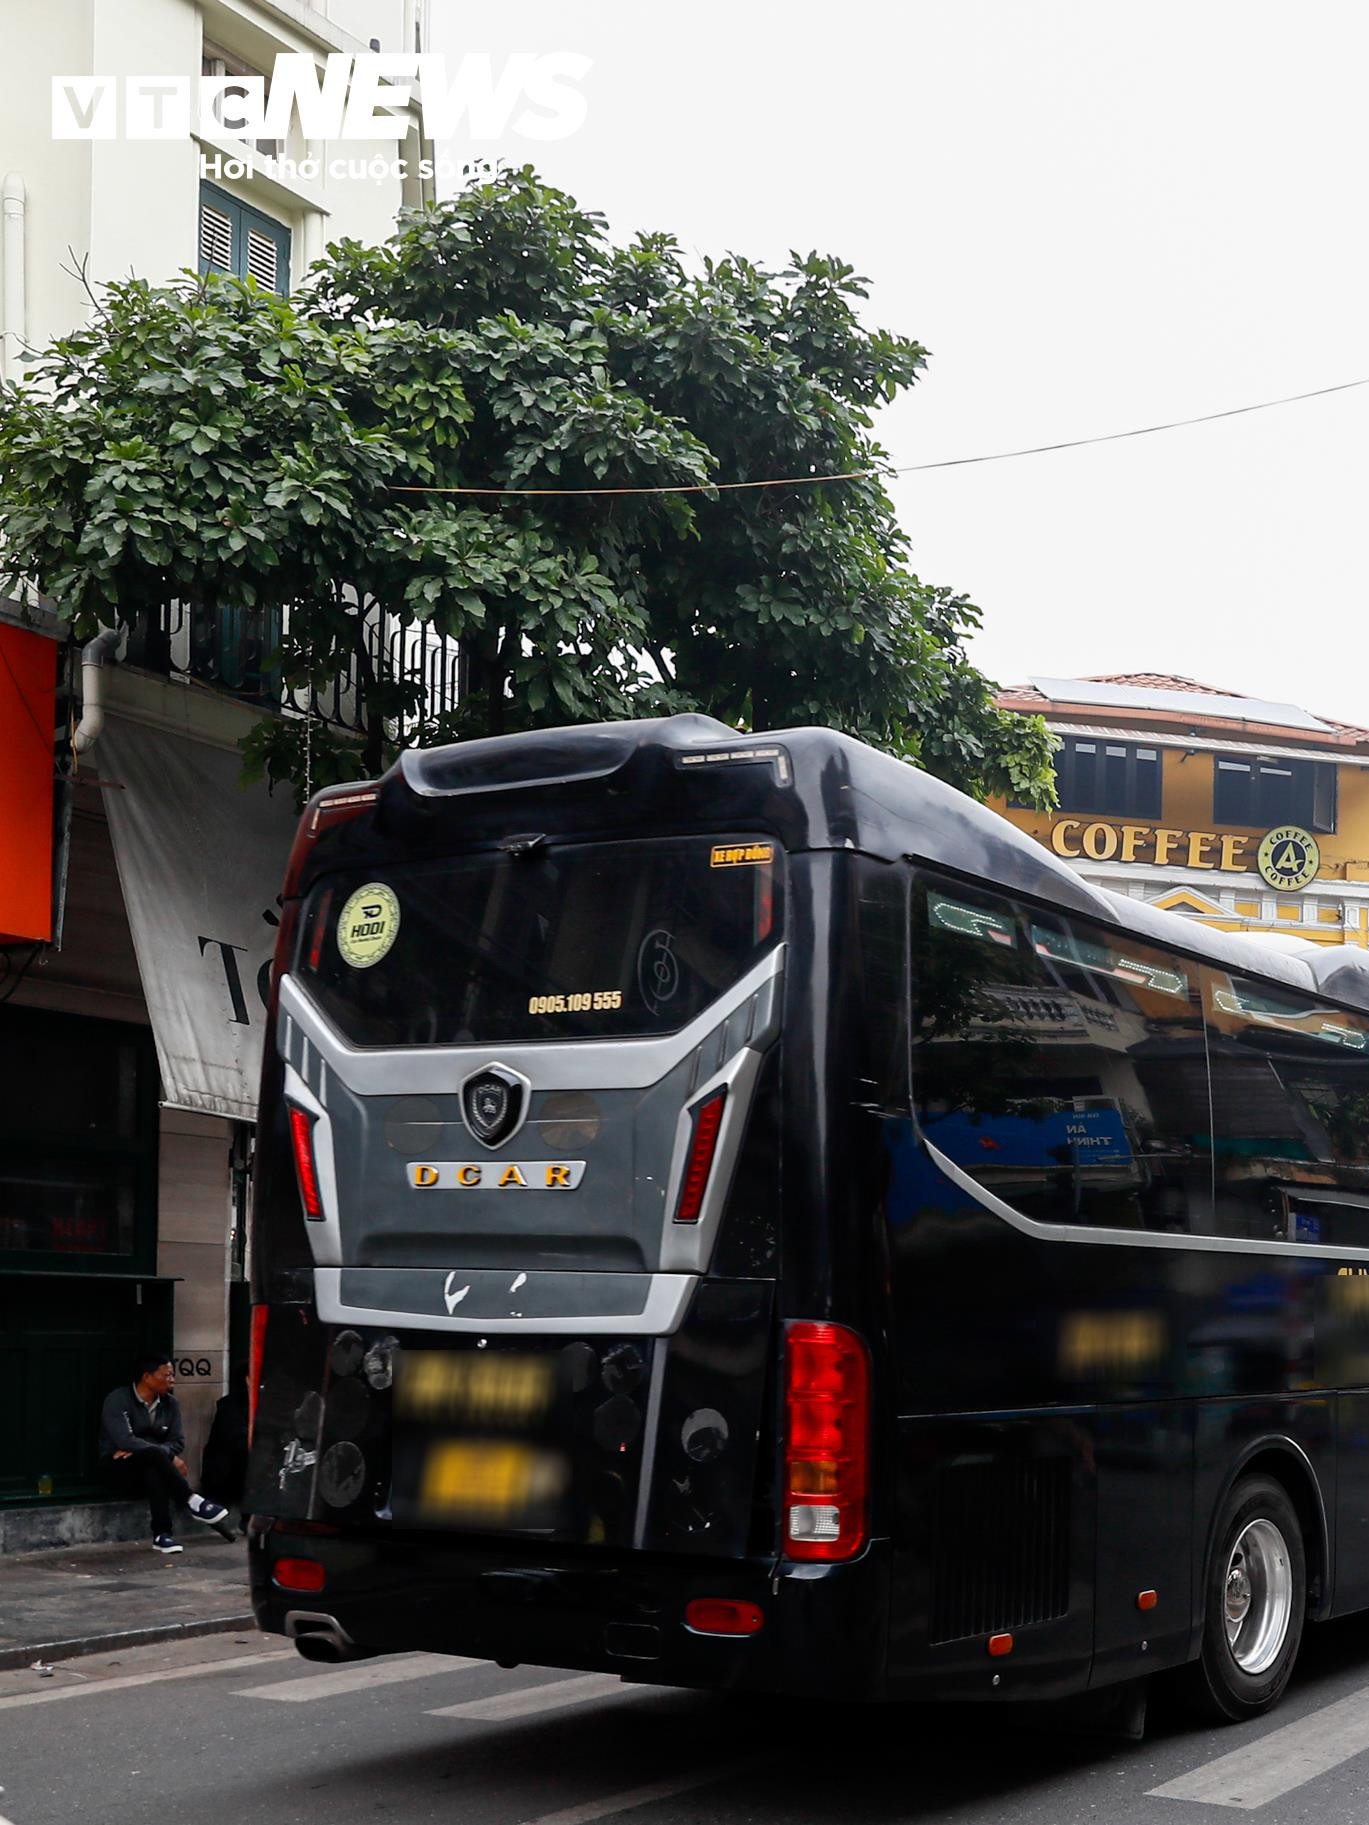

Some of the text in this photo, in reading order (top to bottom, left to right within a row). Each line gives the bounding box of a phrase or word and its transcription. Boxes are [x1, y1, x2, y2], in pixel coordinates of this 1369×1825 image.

[1051, 819, 1249, 872] COFFEE
[1270, 830, 1314, 851] COFFEE
[1264, 866, 1310, 887] COFFEE
[528, 990, 623, 1015] 0905.109 555
[413, 1164, 572, 1188] DCAR
